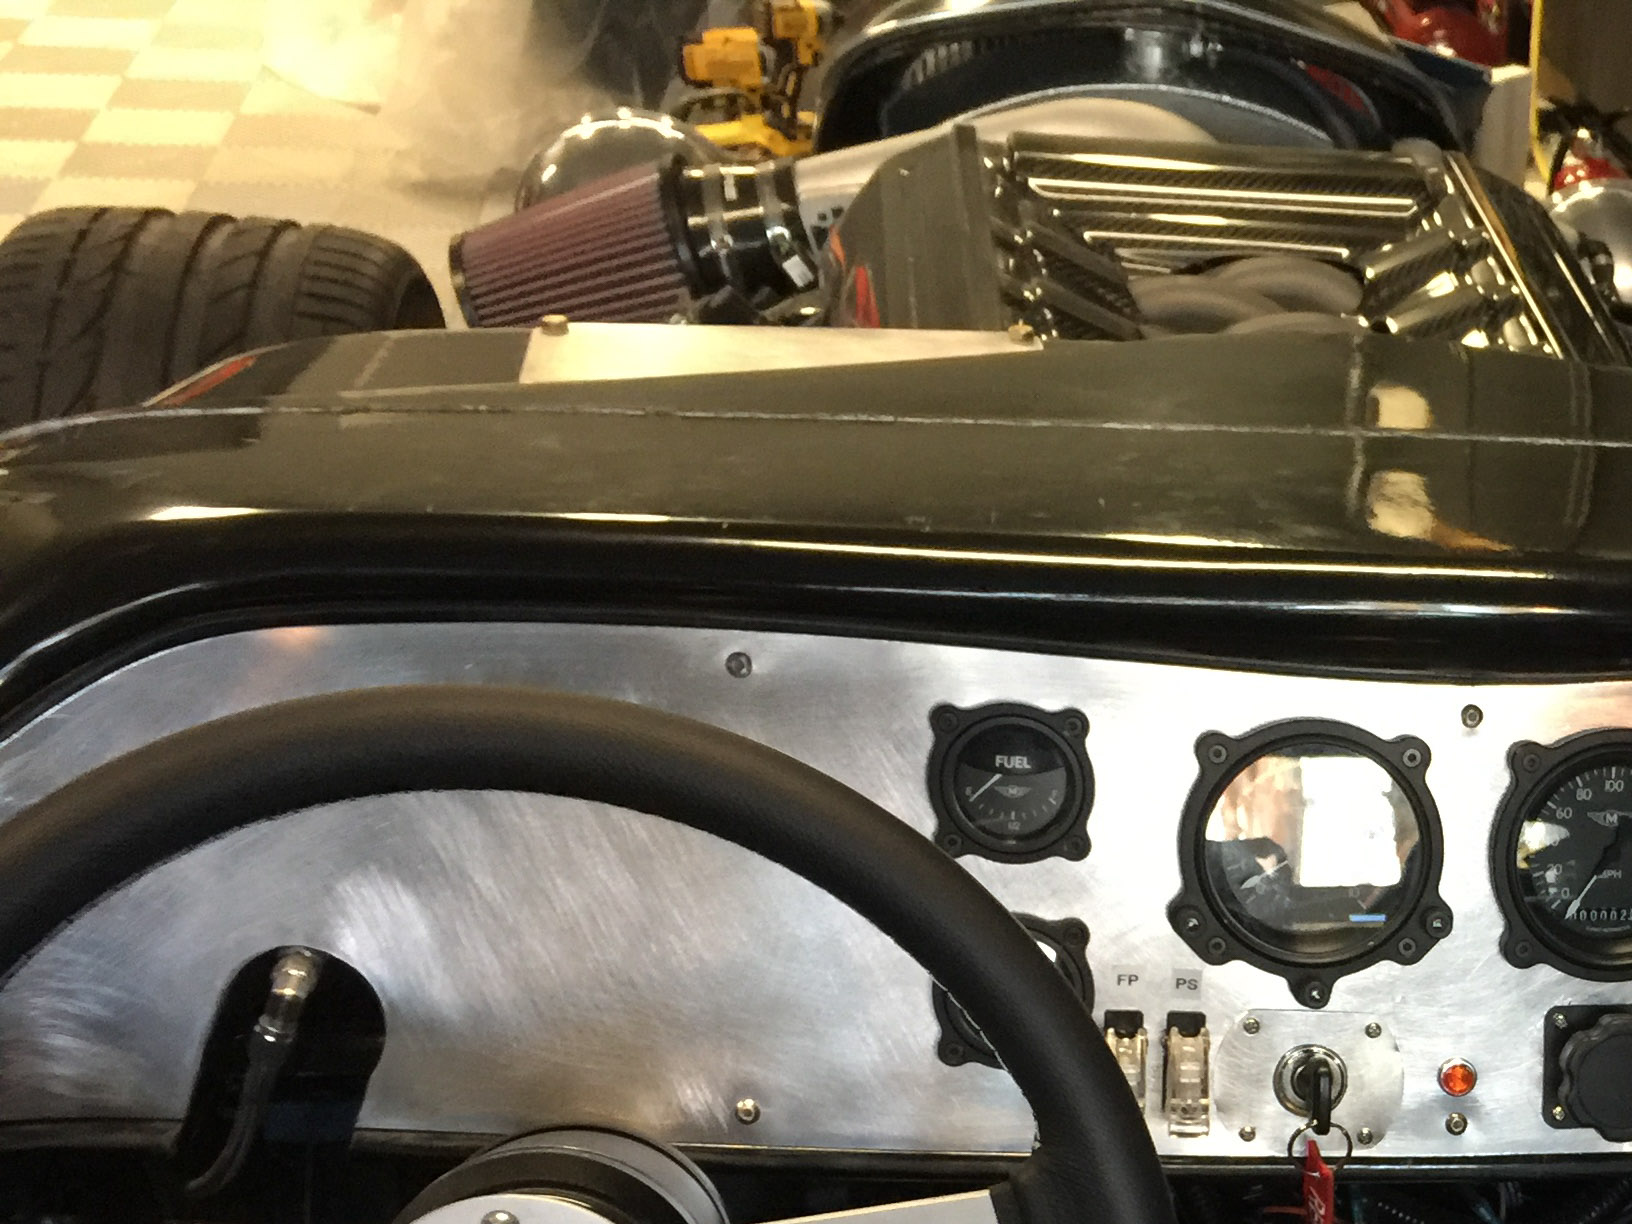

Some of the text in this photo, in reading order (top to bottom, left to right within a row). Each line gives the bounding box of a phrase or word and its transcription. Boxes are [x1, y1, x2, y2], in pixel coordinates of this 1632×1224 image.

[994, 754, 1032, 769] FUEL
[1604, 779, 1625, 793] 100
[1575, 787, 1593, 801] 80
[1555, 806, 1573, 820] 60
[1560, 886, 1570, 899] 0
[1116, 973, 1139, 987] FP
[1175, 977, 1199, 991] PS
